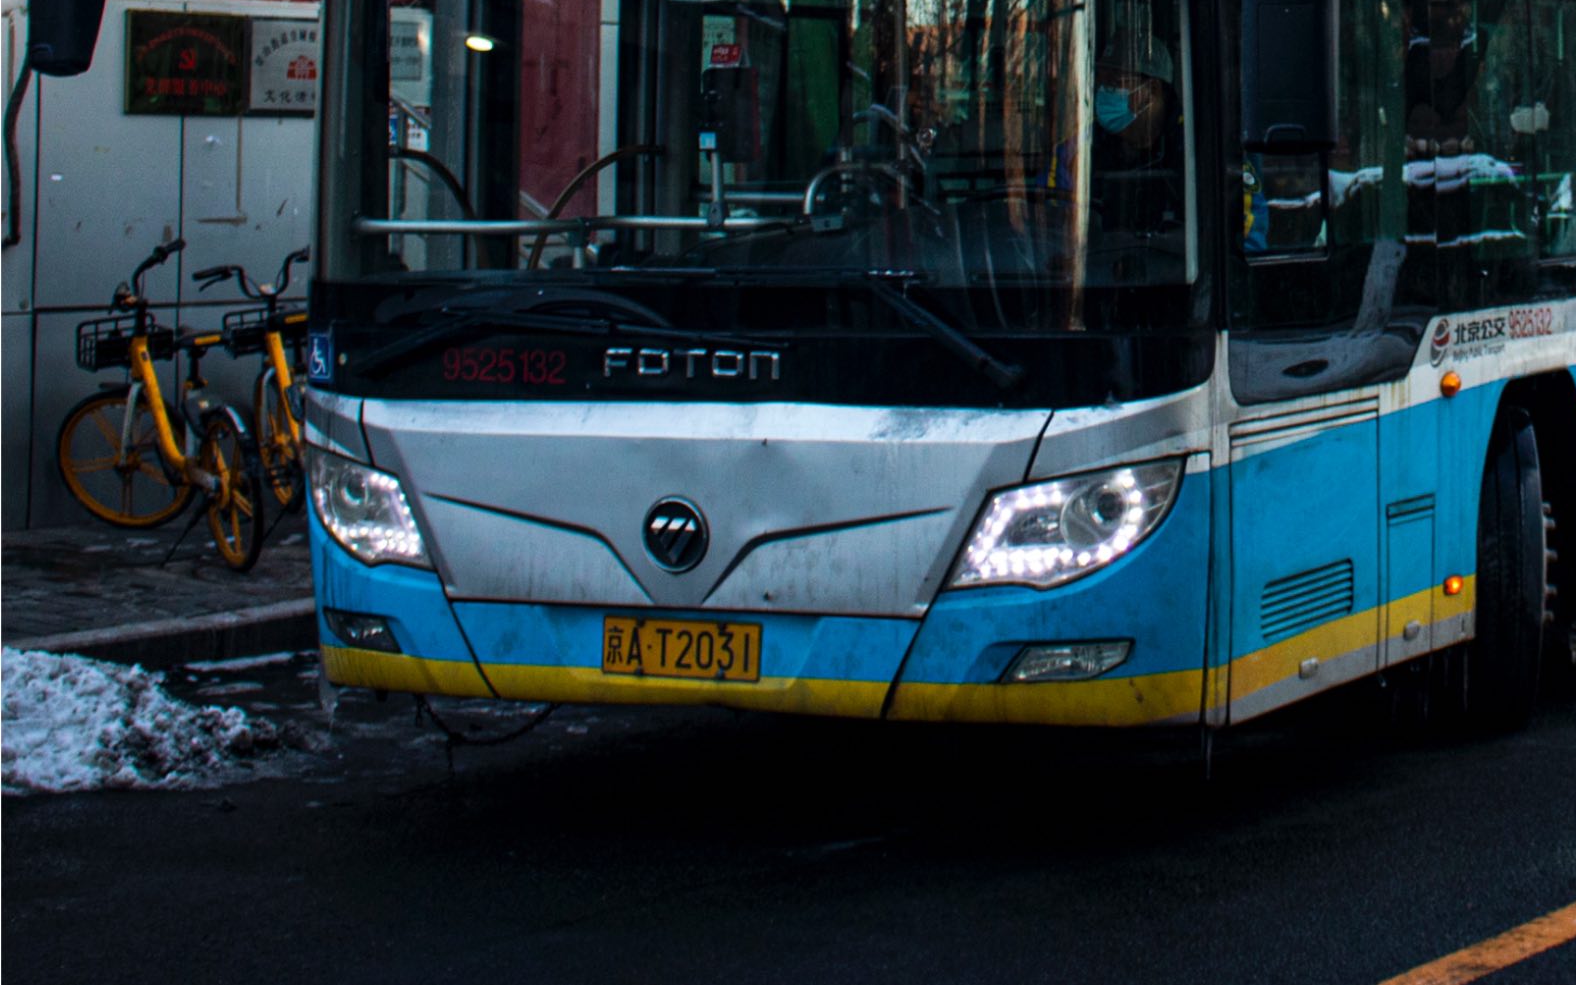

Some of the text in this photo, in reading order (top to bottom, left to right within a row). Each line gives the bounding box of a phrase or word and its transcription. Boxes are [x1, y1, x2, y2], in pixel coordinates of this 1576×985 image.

[1453, 308, 1553, 345] 北京公交 9525132
[443, 347, 568, 385] 9525132
[604, 347, 781, 381] FOTON
